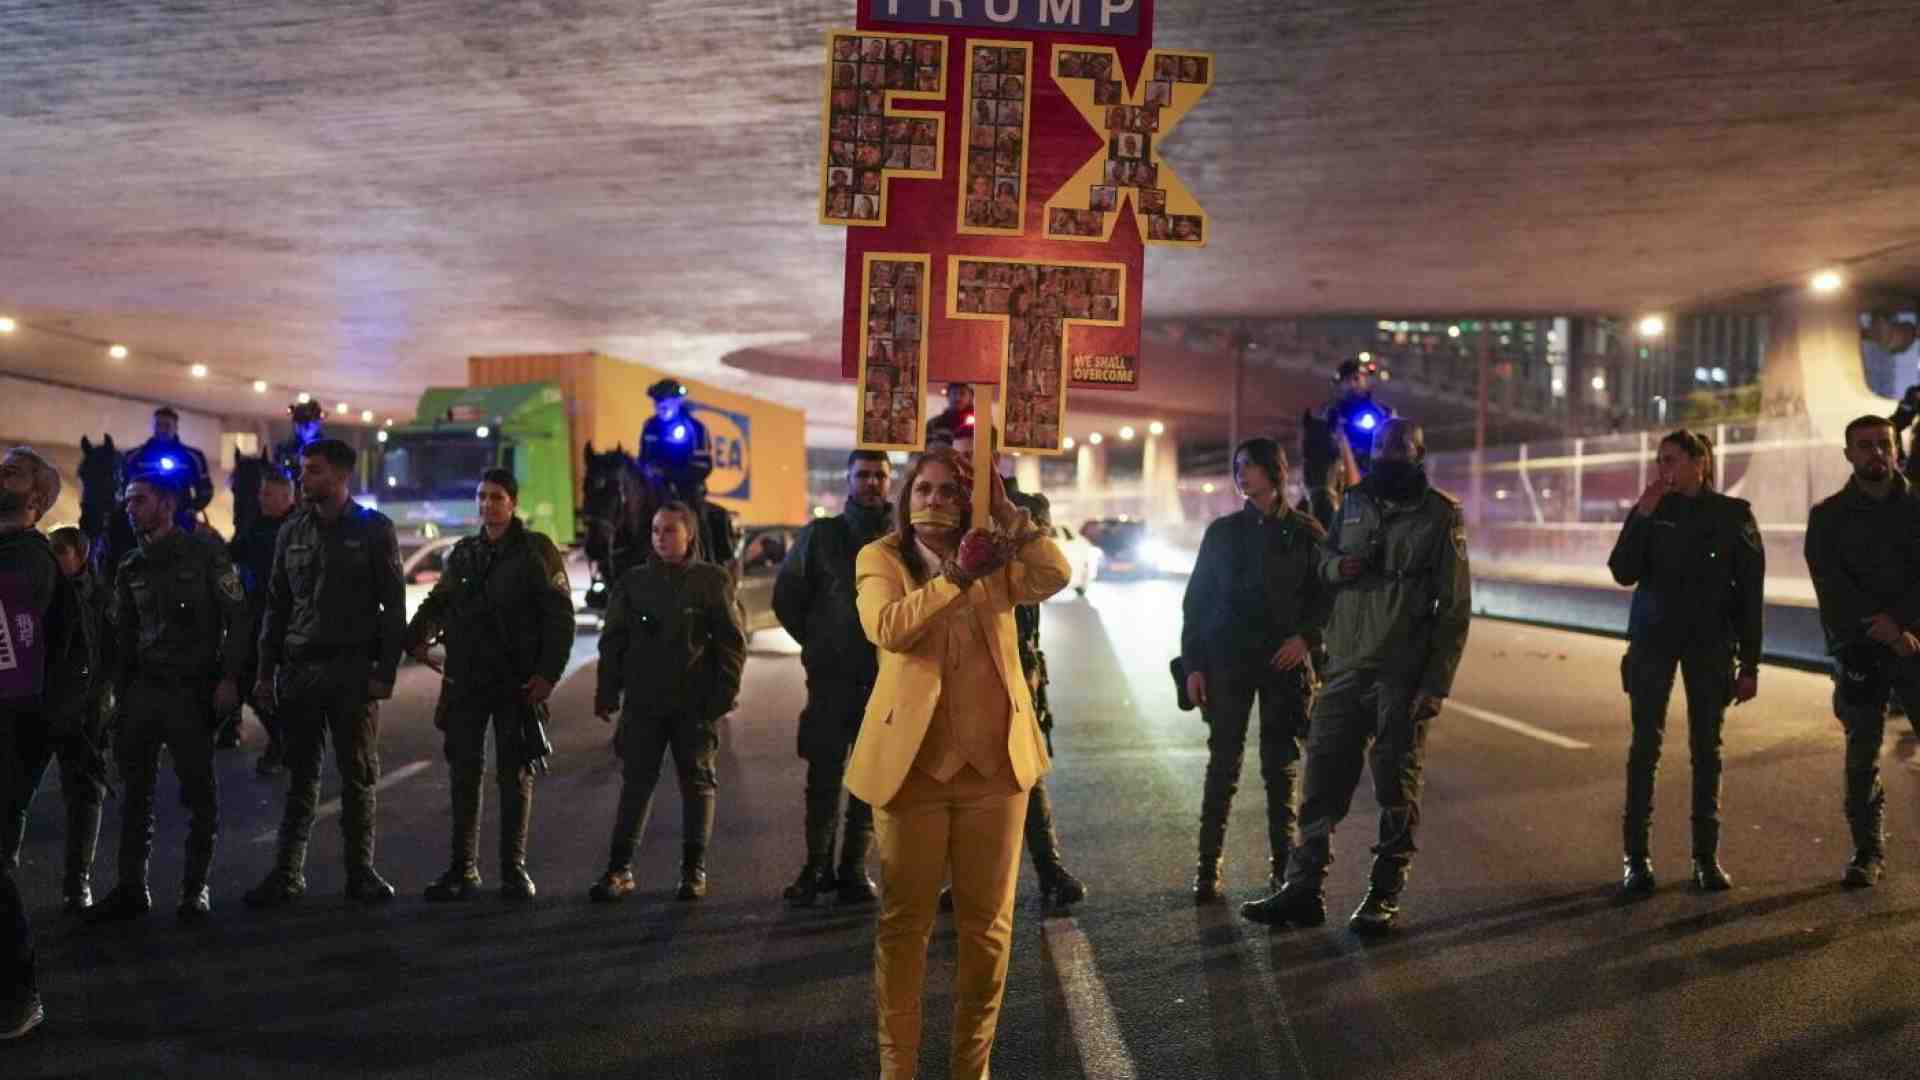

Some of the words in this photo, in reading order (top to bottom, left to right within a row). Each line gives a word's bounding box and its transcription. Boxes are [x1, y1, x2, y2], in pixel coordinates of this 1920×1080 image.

[819, 30, 1216, 248] FIX
[857, 251, 1127, 455] IT
[1074, 355, 1092, 368] WE
[1095, 355, 1126, 369] SHALL
[1074, 367, 1134, 382] OVERCOME
